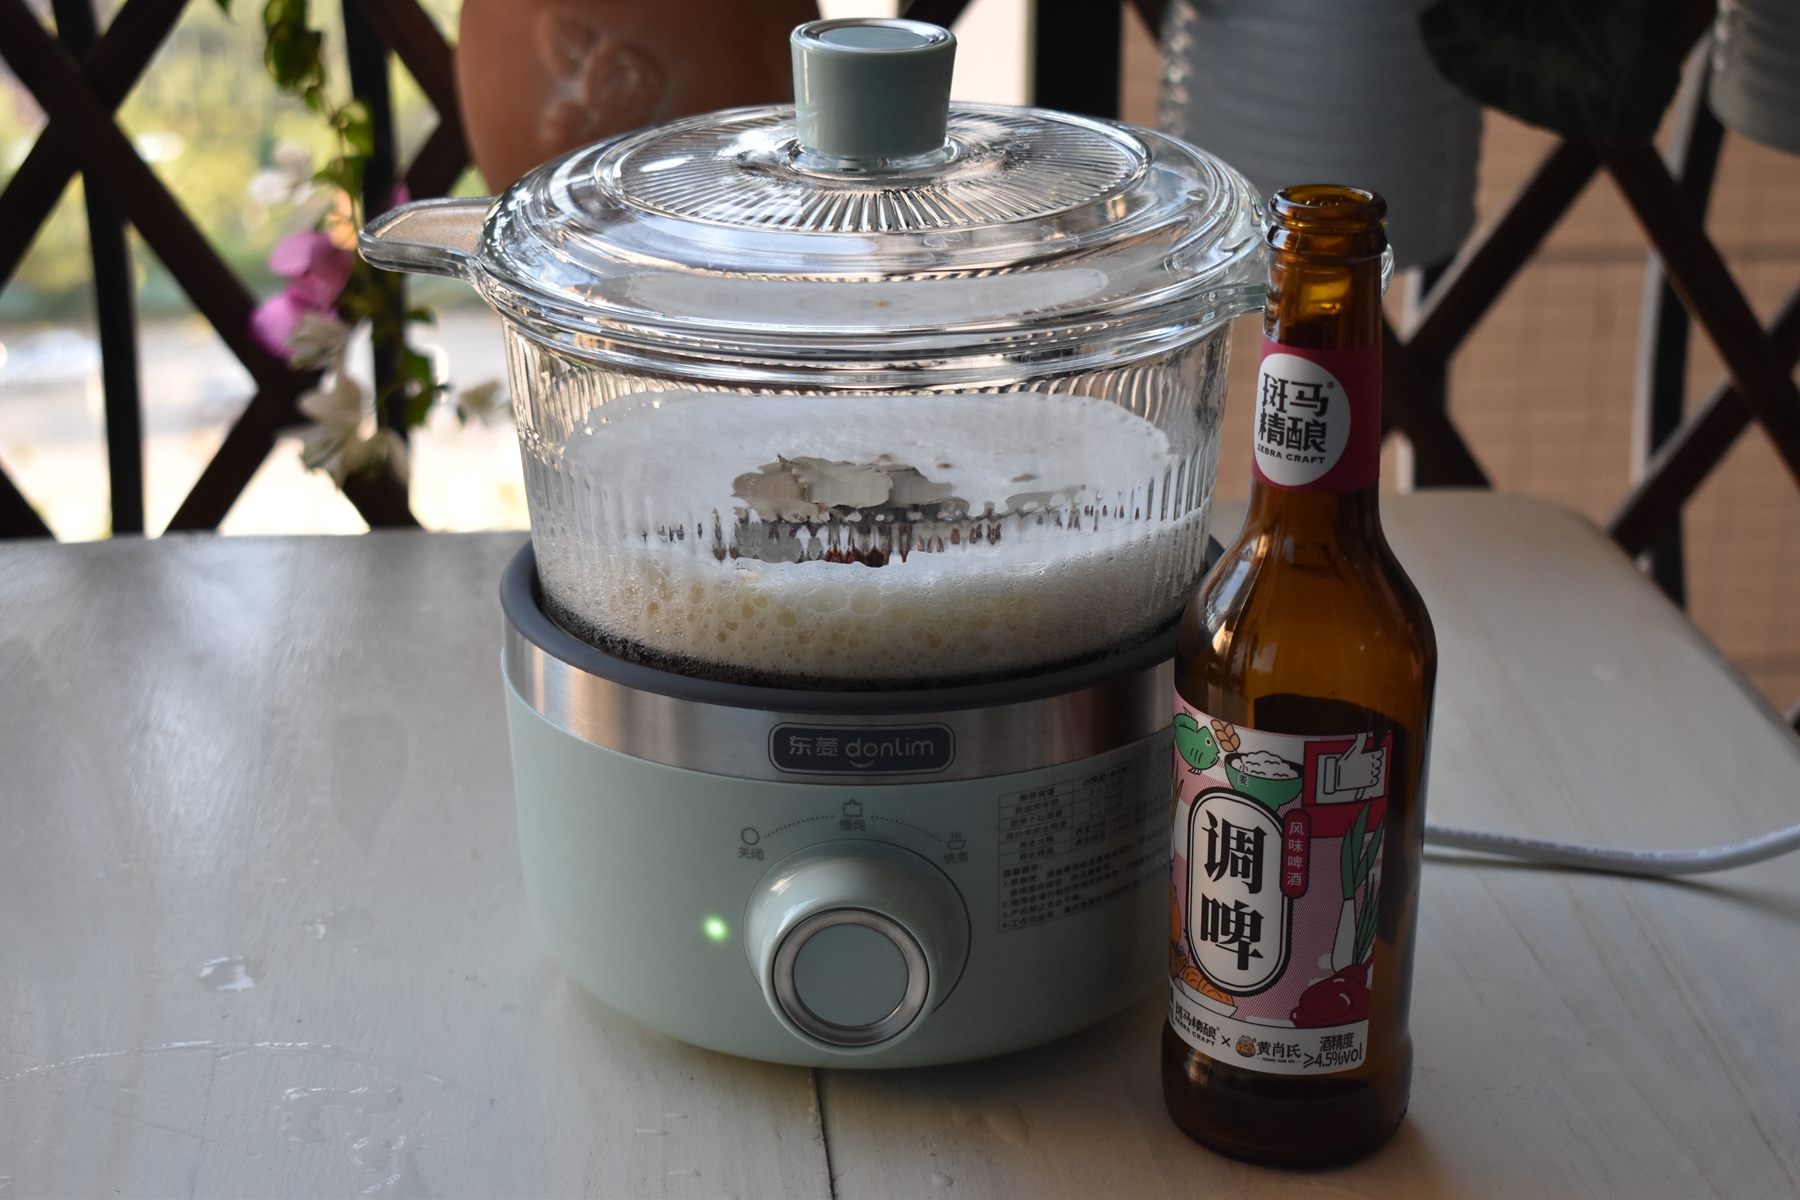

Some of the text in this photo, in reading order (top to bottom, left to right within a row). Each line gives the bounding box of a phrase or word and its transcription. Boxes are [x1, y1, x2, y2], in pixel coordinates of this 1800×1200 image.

[1262, 372, 1329, 418] 斑马
[1258, 408, 1327, 453] 精酿
[1257, 443, 1326, 464] ZEBRA CRAFT
[789, 735, 934, 758] 东菱 donlim
[839, 818, 867, 832] 慢炖
[738, 846, 764, 861] 关闭
[943, 852, 969, 864] 快煮
[1286, 821, 1305, 886] 风味啤酒
[1200, 809, 1268, 971] 调啤
[1256, 1040, 1302, 1059] 黄肖氏
[1320, 1032, 1354, 1052] 酒精度
